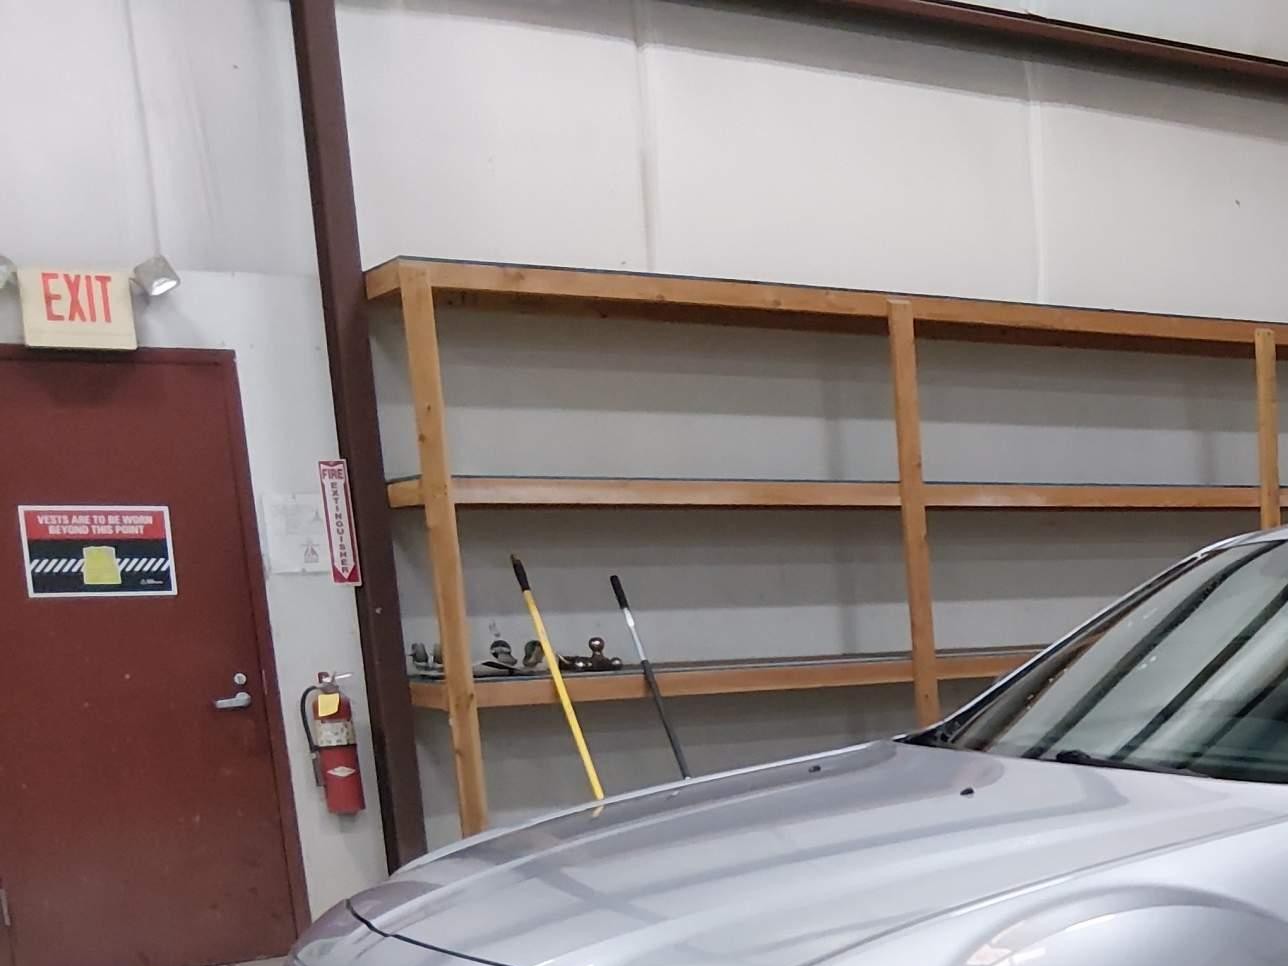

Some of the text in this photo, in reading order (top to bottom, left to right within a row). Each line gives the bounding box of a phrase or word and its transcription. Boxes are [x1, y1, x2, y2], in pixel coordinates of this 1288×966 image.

[41, 272, 112, 323] EXIT
[322, 468, 344, 480] FIRE
[37, 515, 153, 525] VESTS ARE TO BE WORN
[48, 525, 145, 534] BEYOND THIS POINT
[330, 481, 348, 573] EXTINGUISHER
